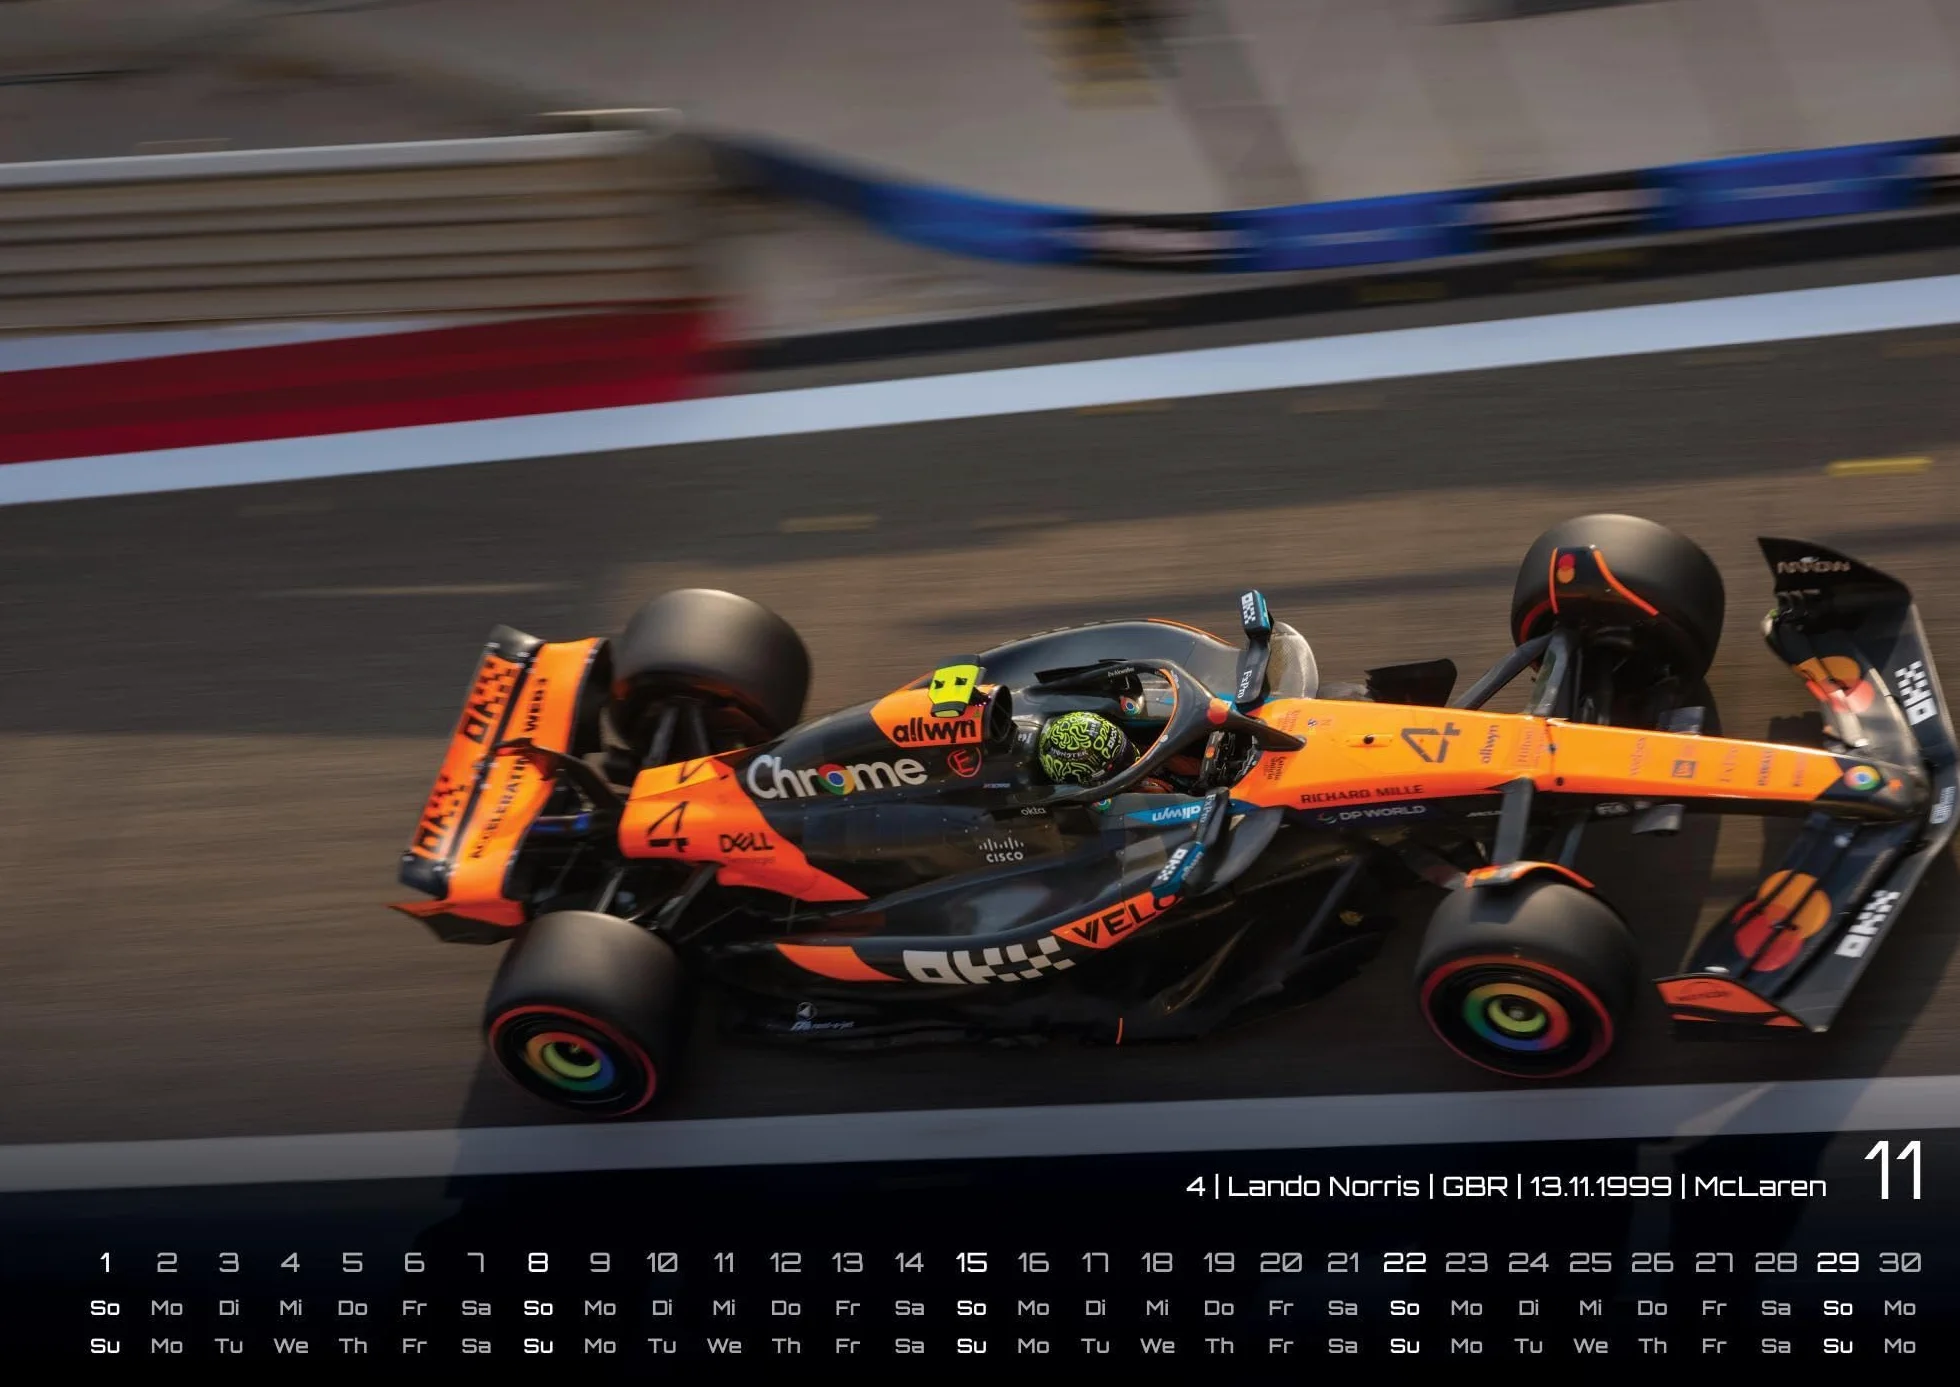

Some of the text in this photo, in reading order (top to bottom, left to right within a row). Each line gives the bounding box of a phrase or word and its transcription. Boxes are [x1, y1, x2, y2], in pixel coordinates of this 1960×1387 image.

[1241, 592, 1256, 625] OKX
[464, 656, 518, 743] OKX
[1237, 669, 1253, 699] FxPro
[1894, 660, 1938, 726] OKX
[892, 716, 977, 744] allwyn
[1399, 722, 1462, 763] 4
[746, 754, 928, 800] Chrome
[955, 754, 970, 771] E
[1300, 784, 1425, 804] RICHARD MILLE
[647, 800, 690, 854] 4
[1021, 807, 1046, 816] okta
[1151, 804, 1202, 822] allwyn
[1339, 804, 1427, 821] DP WORLD
[719, 832, 775, 853] DELL
[1157, 848, 1189, 882] OKX
[1834, 890, 1900, 958] OKX
[903, 935, 1077, 985] OKX
